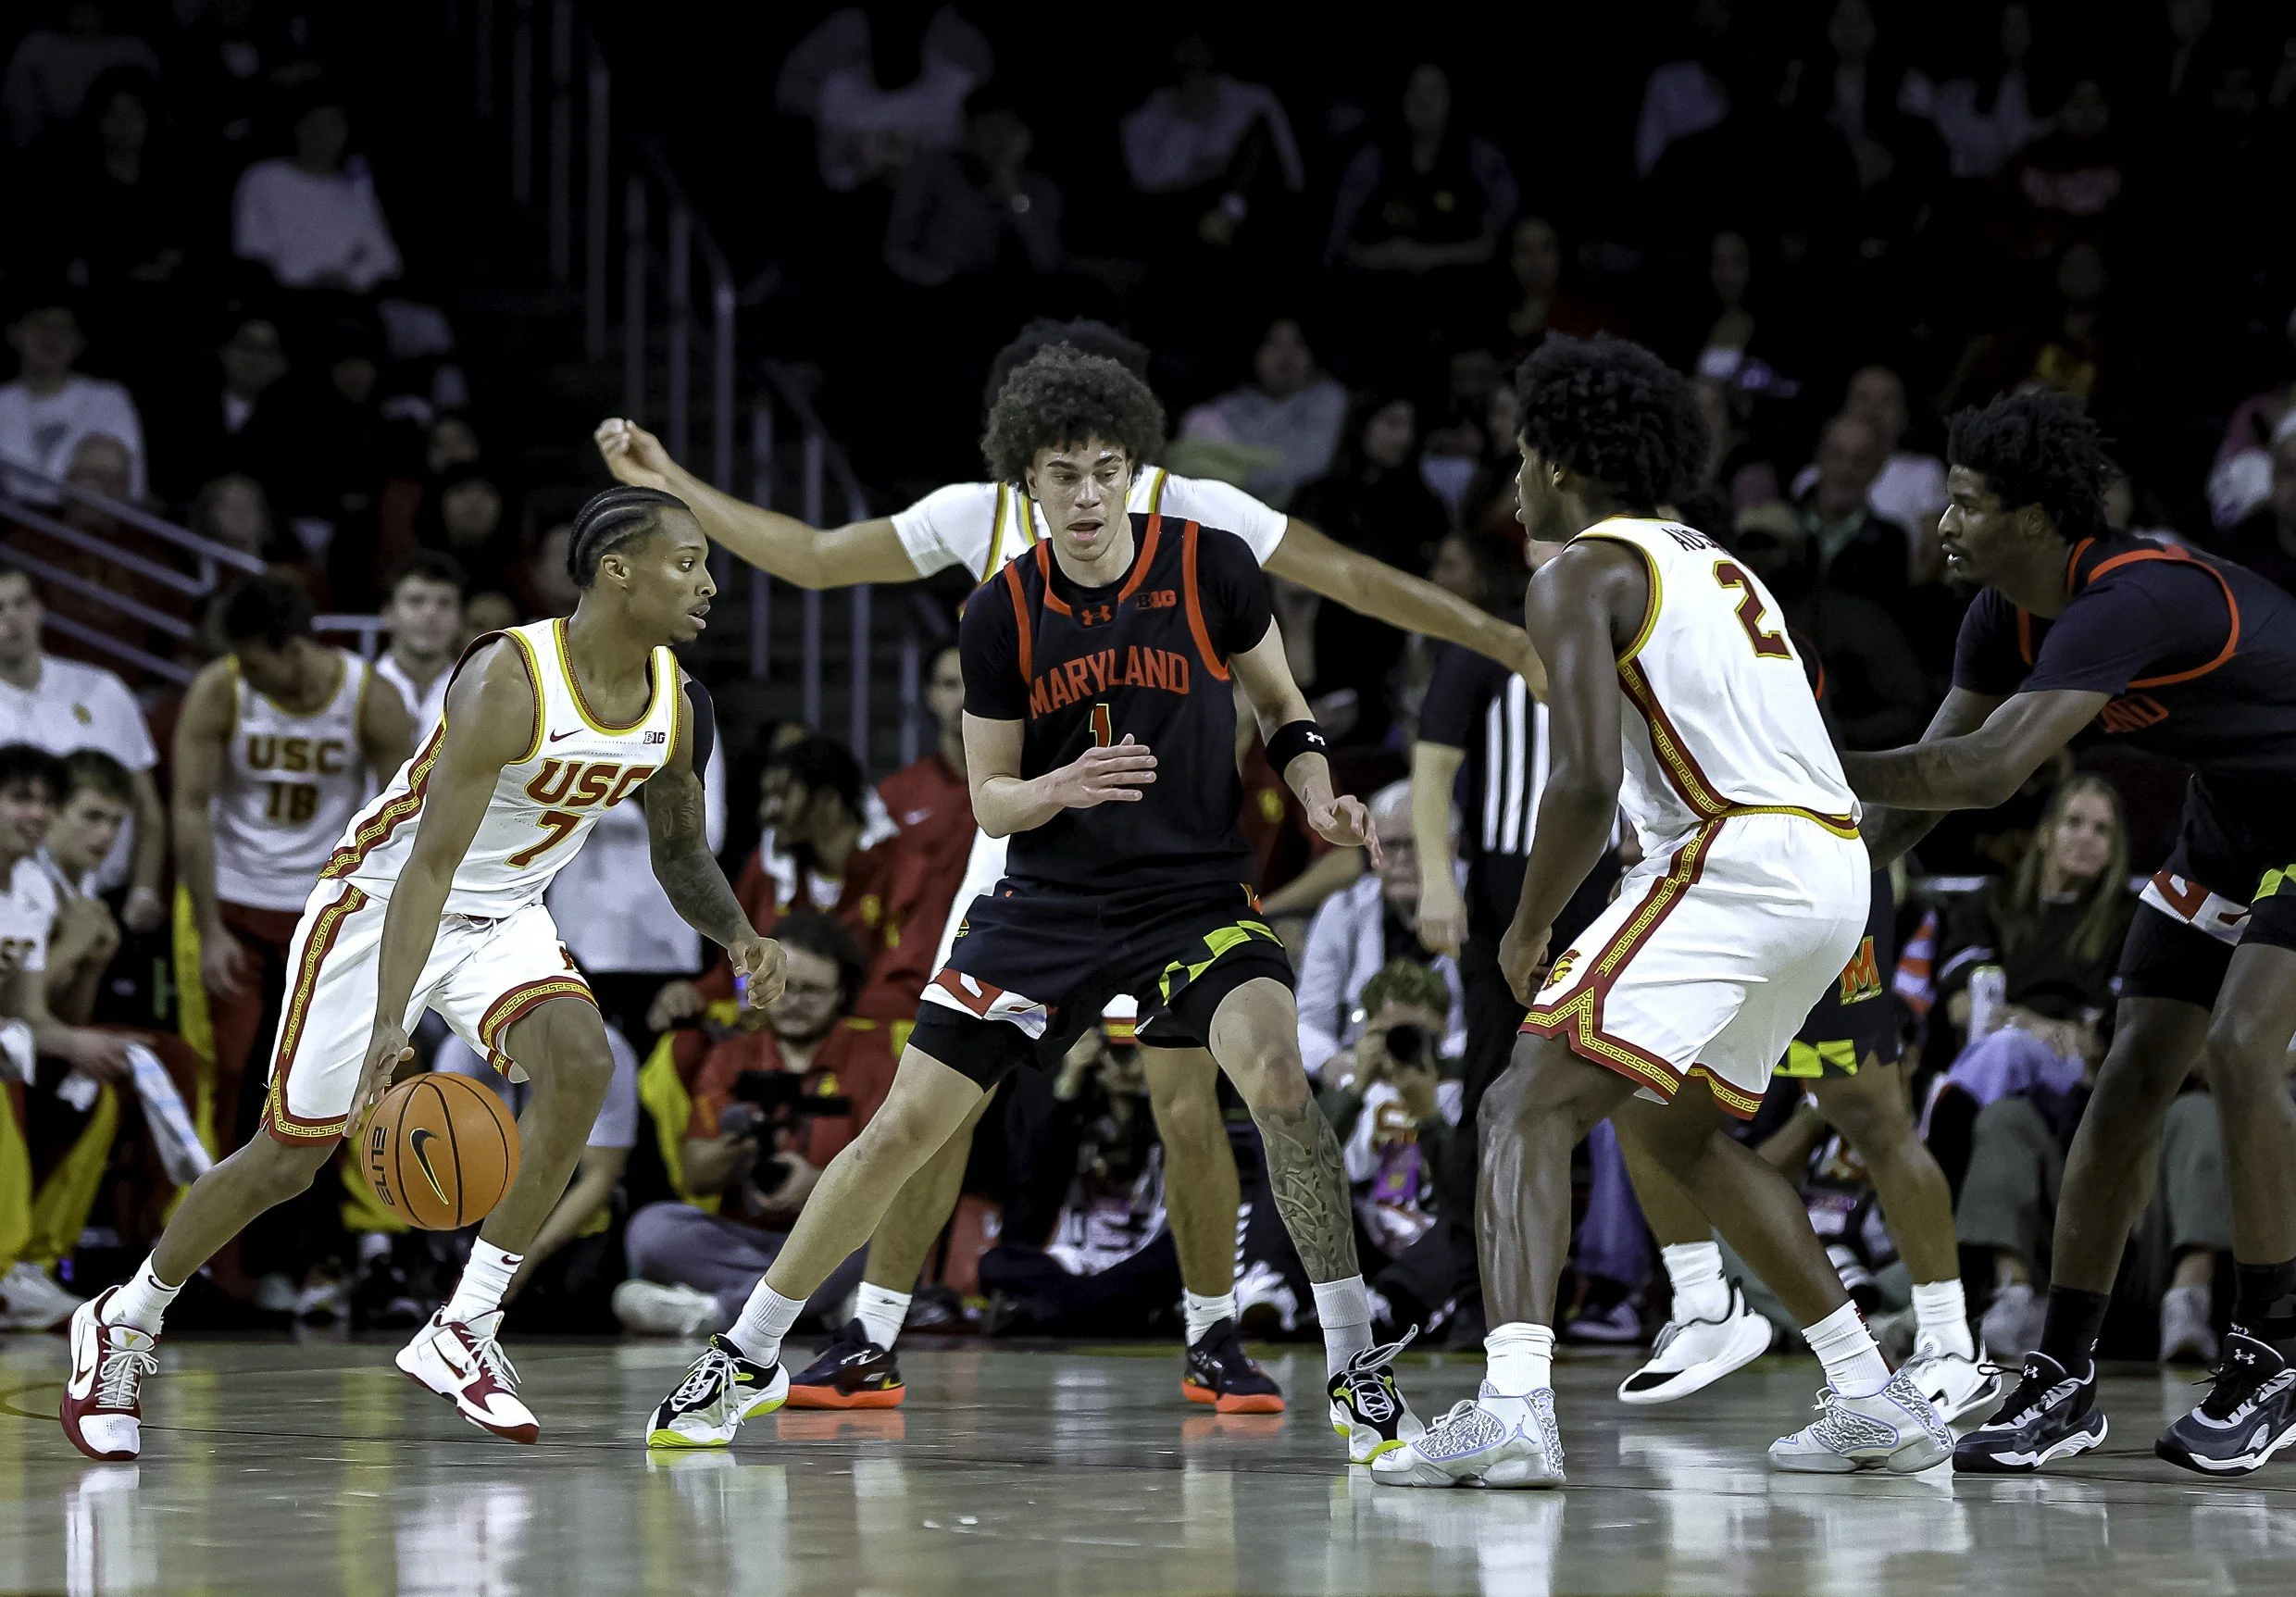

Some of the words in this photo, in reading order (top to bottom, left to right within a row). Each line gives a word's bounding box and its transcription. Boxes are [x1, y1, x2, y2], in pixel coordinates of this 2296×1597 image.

[1713, 560, 1793, 660] 2
[1029, 645, 1191, 720] MARYLAND
[1089, 704, 1111, 748] 1
[246, 736, 343, 776] USC
[524, 758, 657, 809] USC
[267, 780, 318, 822] 18
[505, 810, 584, 870] 7
[371, 1126, 396, 1206] ELITE
